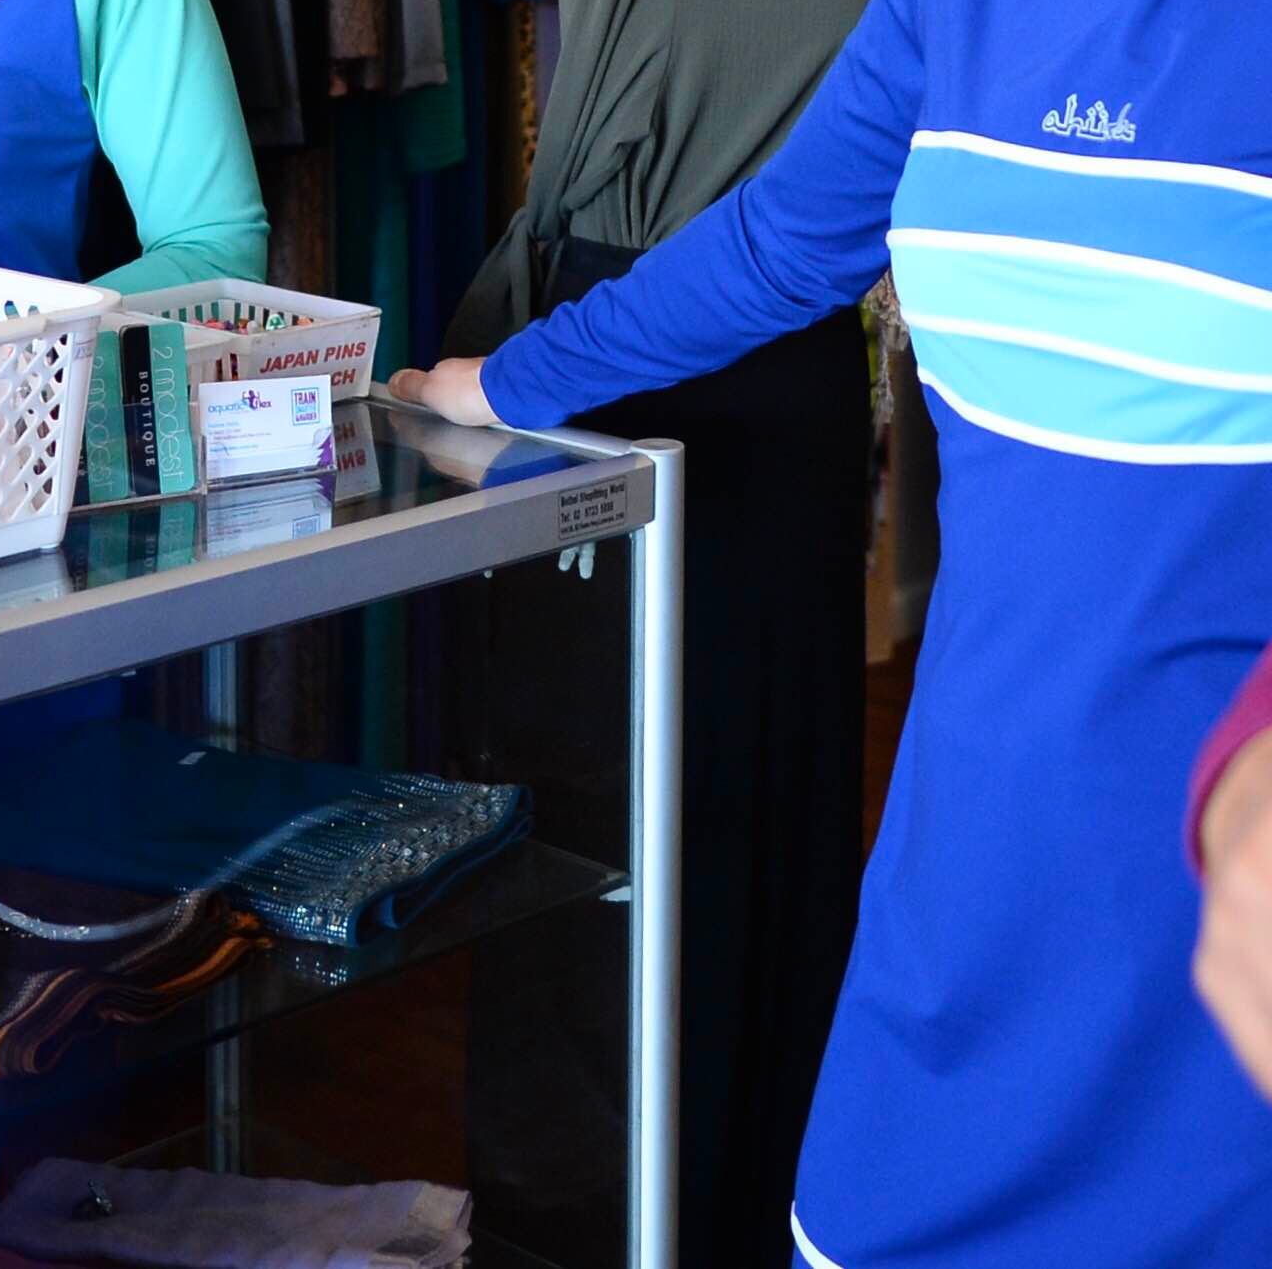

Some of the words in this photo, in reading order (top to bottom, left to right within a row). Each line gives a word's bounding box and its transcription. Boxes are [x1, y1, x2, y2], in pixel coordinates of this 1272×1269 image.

[154, 346, 174, 361] 2
[259, 349, 320, 374] JAPAN
[324, 342, 367, 363] PINS
[294, 391, 316, 406] TRAIN
[138, 371, 156, 467] BOUTIQUE
[156, 367, 185, 485] modest
